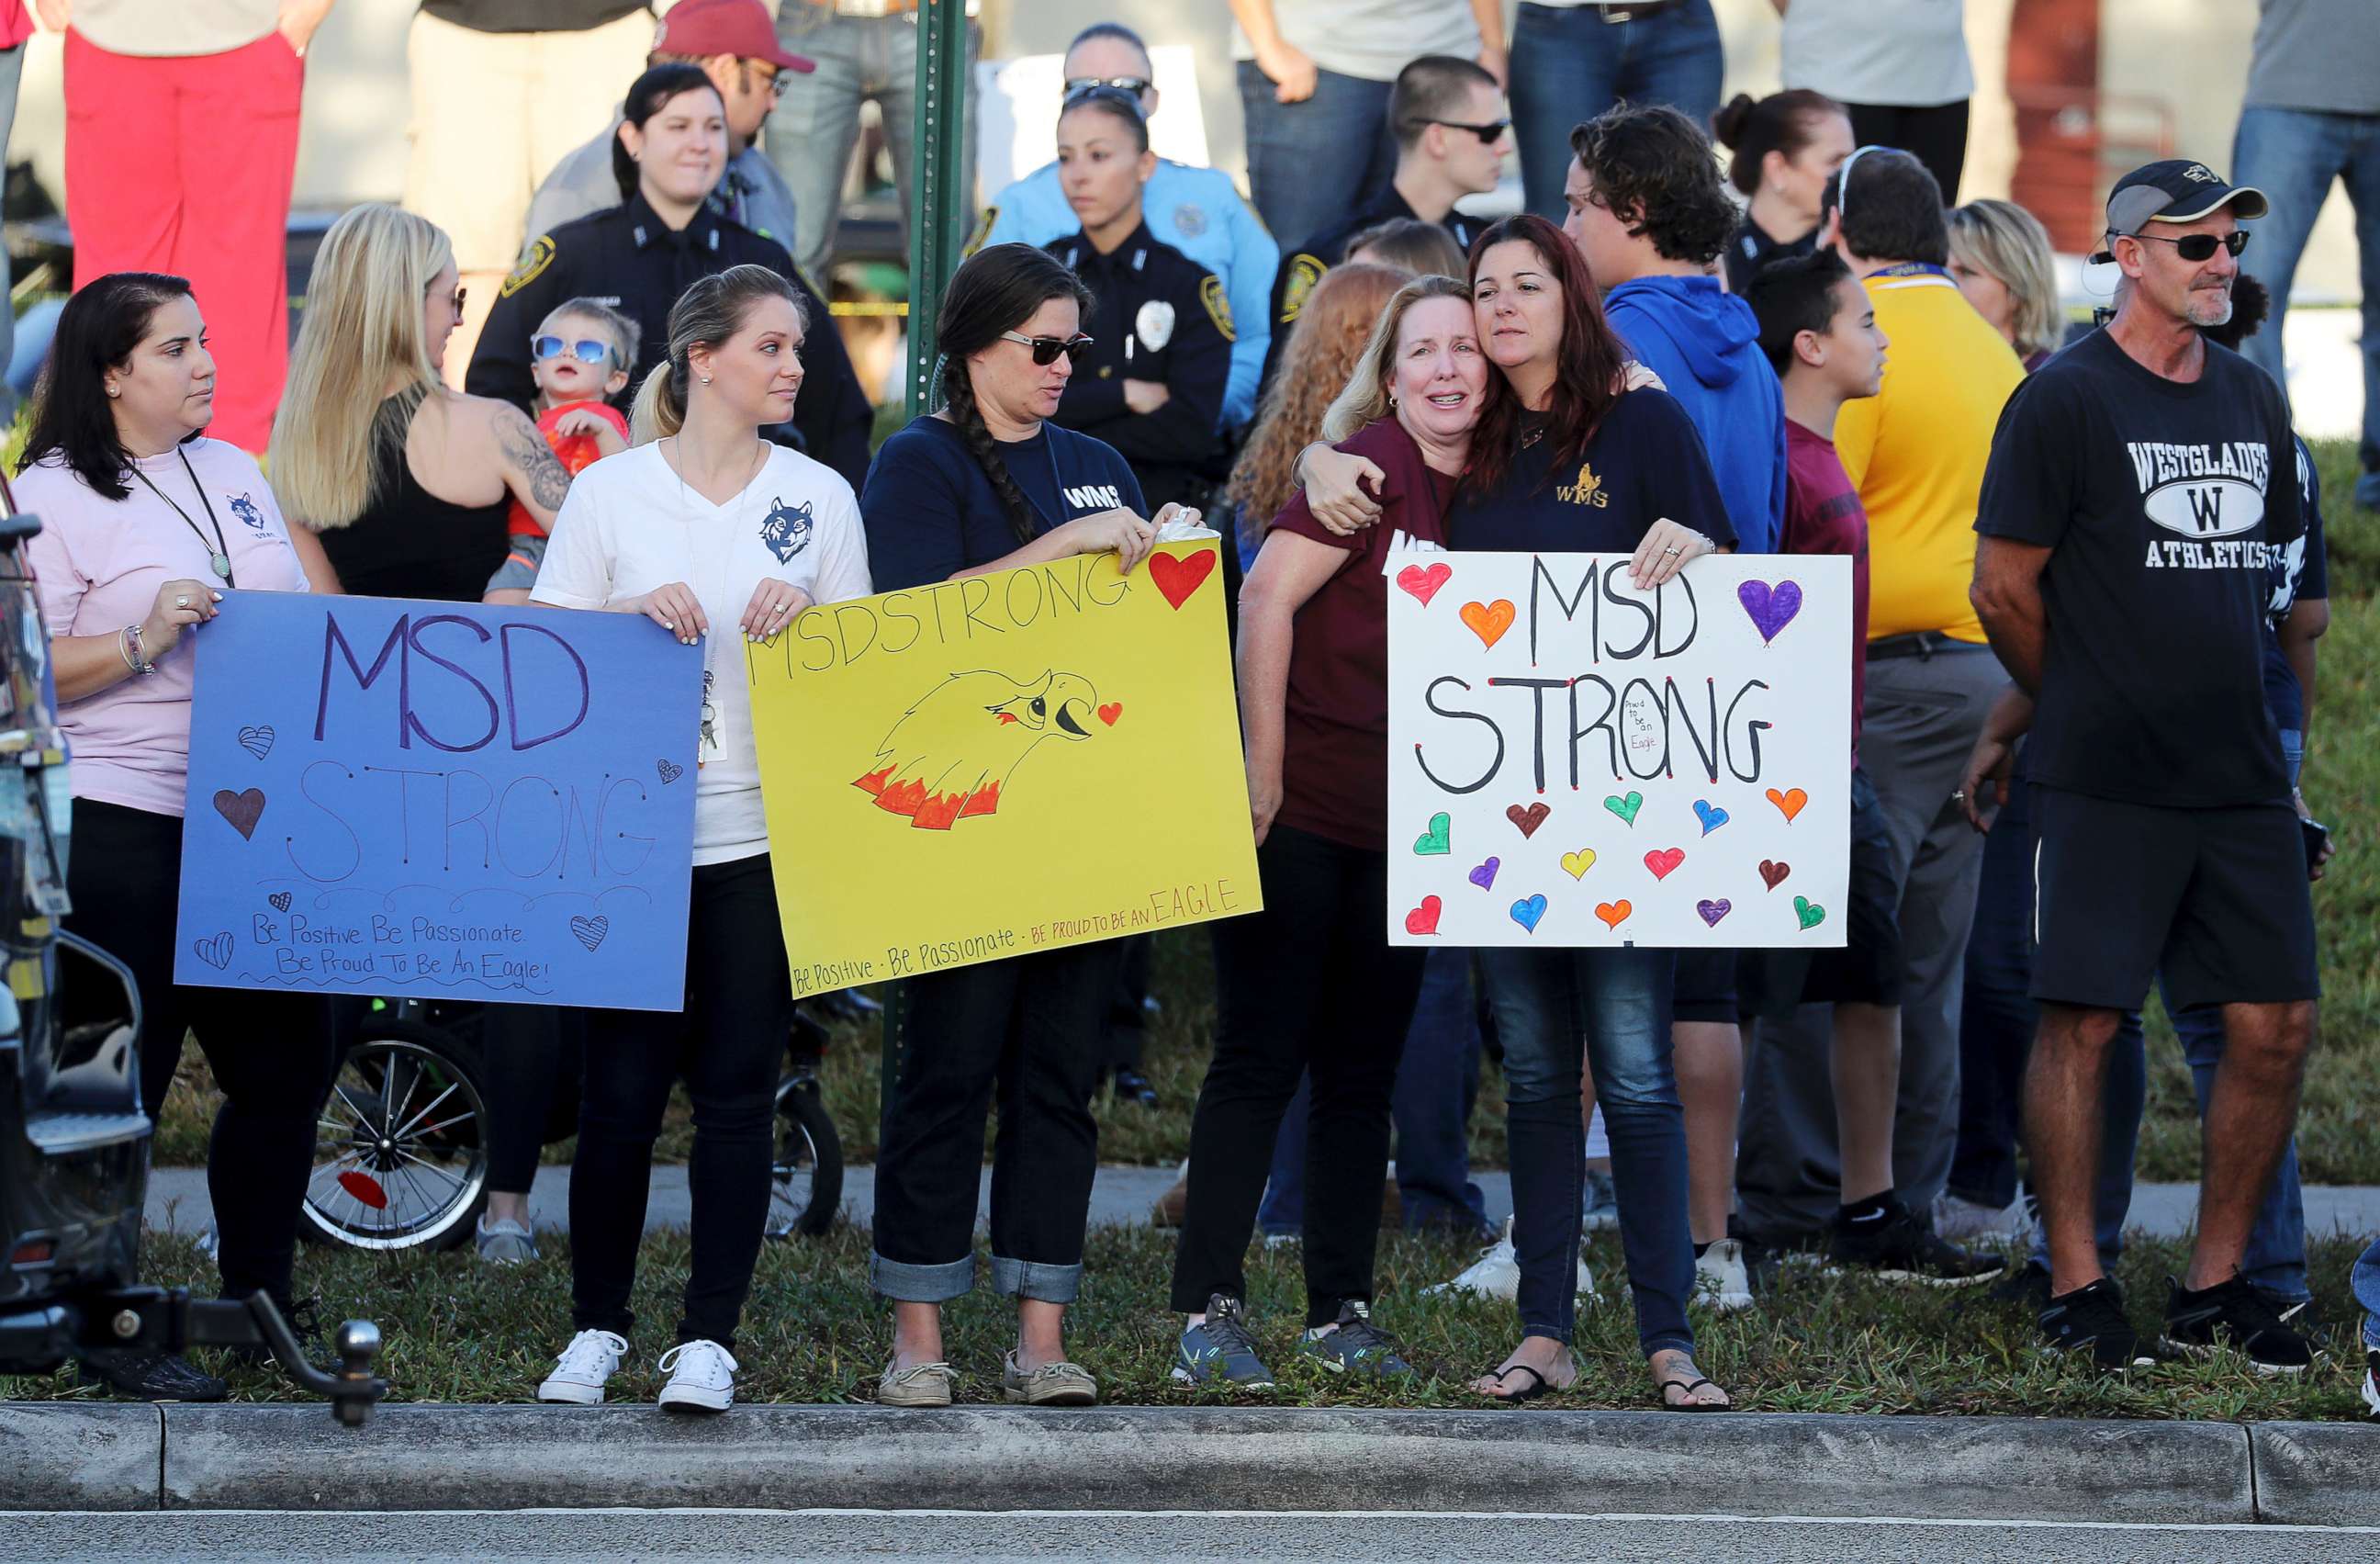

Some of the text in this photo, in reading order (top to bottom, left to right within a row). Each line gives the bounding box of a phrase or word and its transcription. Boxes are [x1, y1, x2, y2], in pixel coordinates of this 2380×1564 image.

[2127, 442, 2269, 501] WESTGLADES
[1556, 485, 1609, 508] WMS
[2186, 487, 2223, 532] W
[2145, 540, 2266, 569] ATHLETICS
[1531, 555, 1699, 667] MSD
[314, 610, 589, 752] MSD
[1414, 673, 1774, 794] STRONG
[1629, 709, 1638, 717] to
[1635, 717, 1645, 726] be
[1631, 735, 1658, 752] Eagle
[286, 759, 657, 883] STRONG
[253, 913, 281, 944] Be
[291, 914, 364, 945] Positive.
[371, 914, 404, 945] Be
[793, 879, 1239, 995] Be Positive Be Passionate BE PROUD TO BE AN EAGLE
[276, 948, 549, 989] Be Proud To Be An Eagle!
